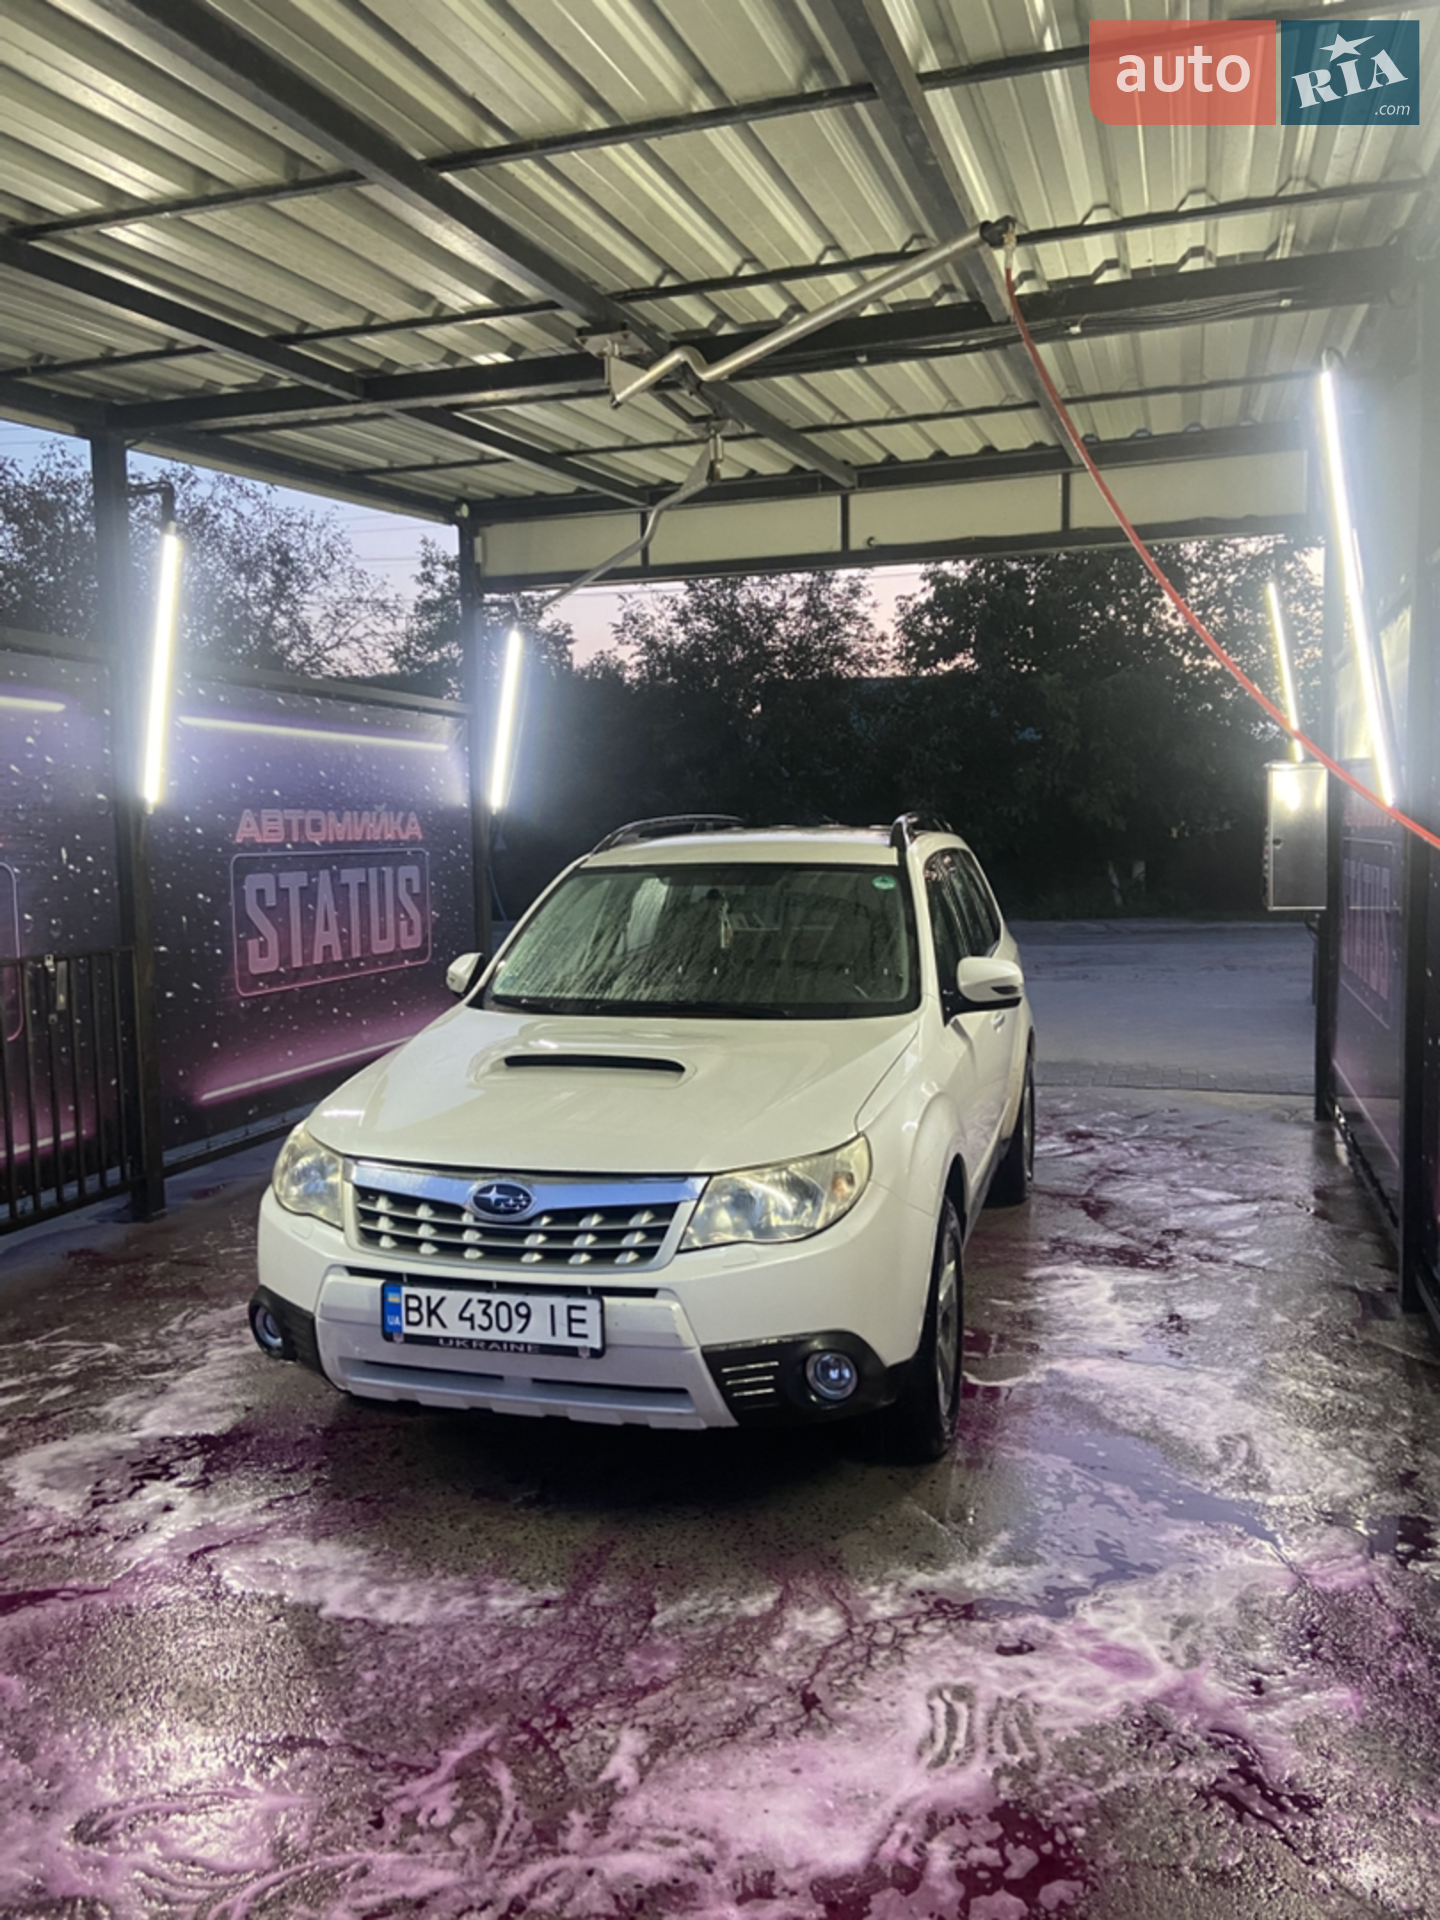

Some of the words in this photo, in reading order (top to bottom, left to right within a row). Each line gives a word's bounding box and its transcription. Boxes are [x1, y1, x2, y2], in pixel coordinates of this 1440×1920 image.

[234, 804, 423, 843] АВТОМИЙКА
[244, 865, 422, 974] STATUS
[404, 1294, 447, 1329] BK
[458, 1298, 531, 1334] 4309
[549, 1304, 589, 1338] IE
[438, 1338, 540, 1353] UKRAINE
